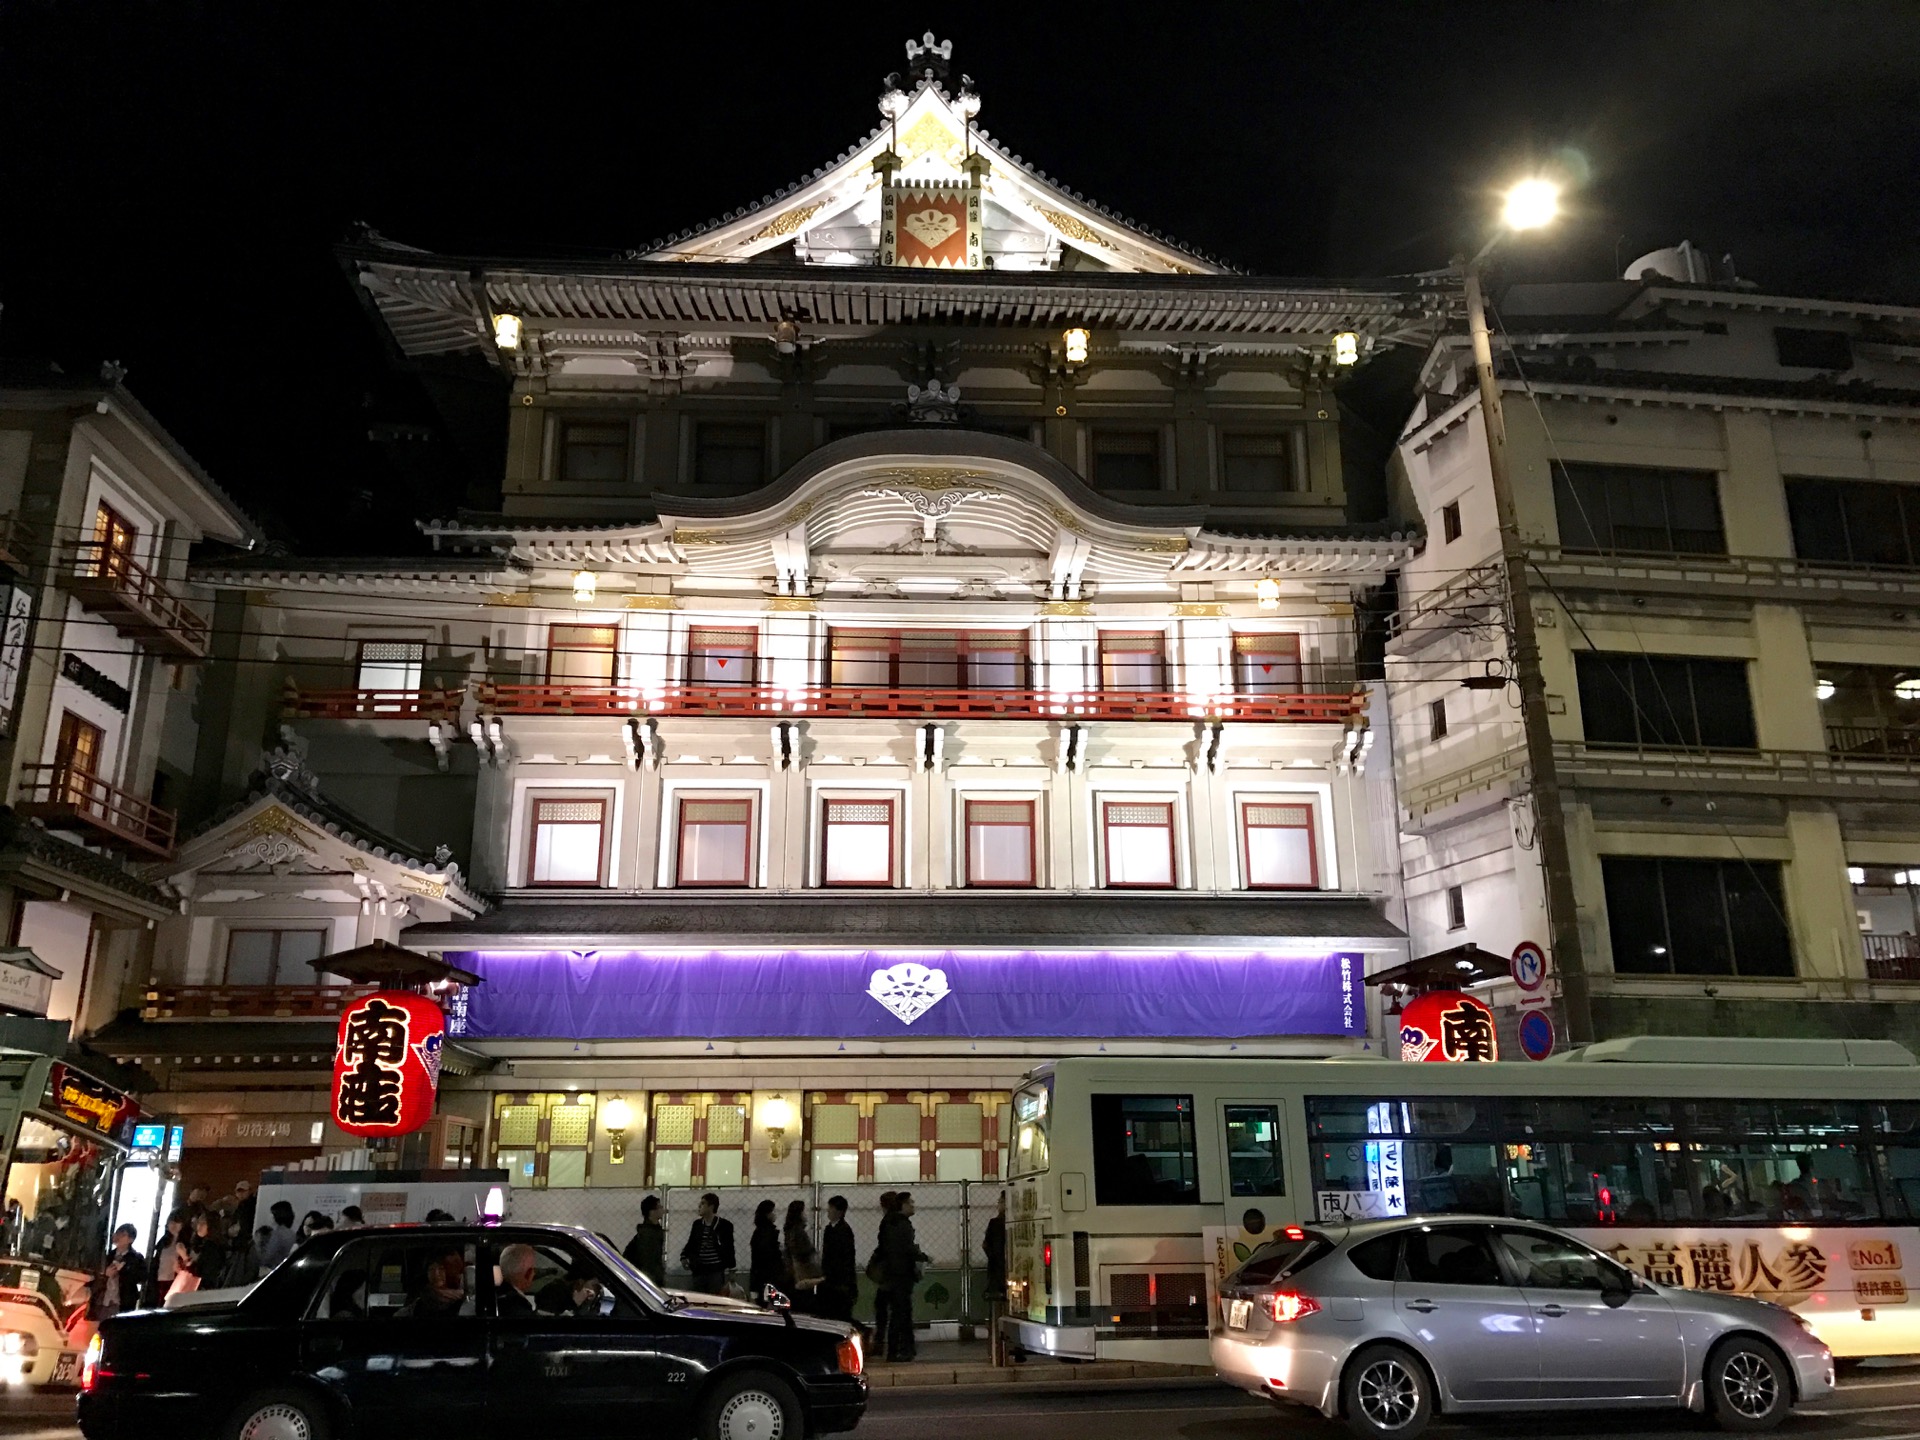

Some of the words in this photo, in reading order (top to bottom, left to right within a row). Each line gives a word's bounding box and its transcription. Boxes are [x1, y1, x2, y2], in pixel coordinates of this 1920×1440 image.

[1341, 957, 1353, 1028] 松竹株式会社
[1322, 1192, 1382, 1212] 市バス
[1859, 1243, 1896, 1265] No.1
[544, 1367, 568, 1377] TAXI
[667, 1373, 686, 1383] 222
